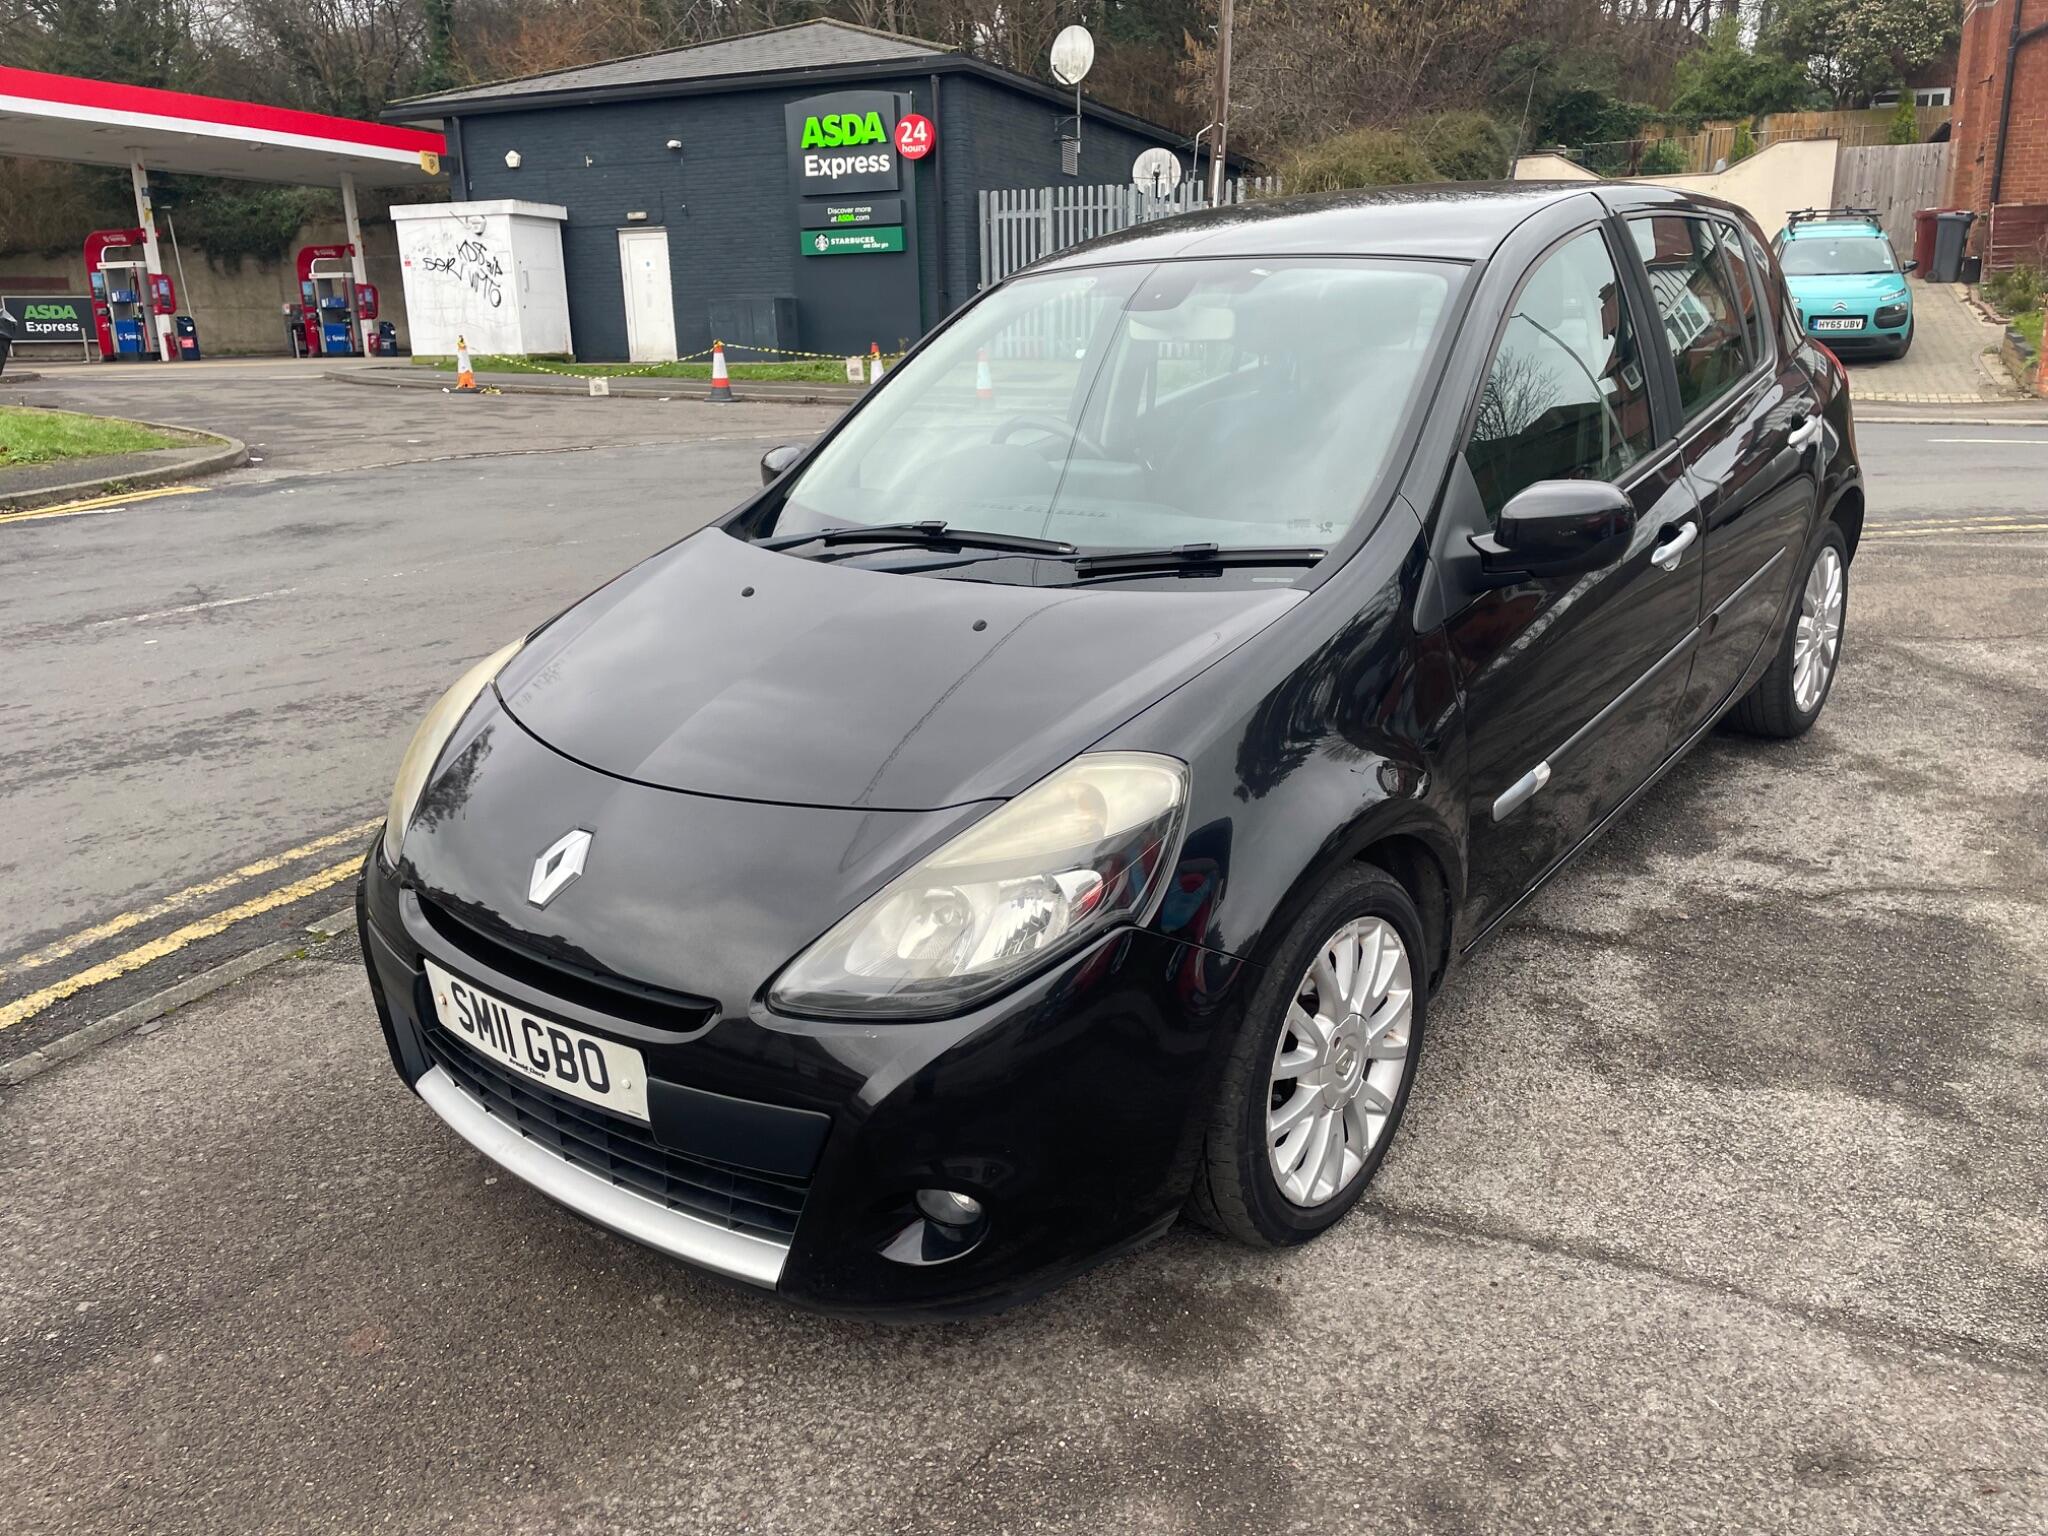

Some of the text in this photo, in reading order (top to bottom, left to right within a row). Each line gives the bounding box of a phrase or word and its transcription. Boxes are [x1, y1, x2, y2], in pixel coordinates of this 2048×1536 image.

[801, 112, 887, 148] ASDA
[901, 121, 927, 143] 24
[902, 144, 926, 153] hours
[804, 154, 890, 180] Express
[827, 207, 854, 215] Discover
[831, 236, 874, 245] STARBUCKS
[24, 305, 78, 320] ASDA
[26, 322, 79, 334] Express
[1819, 320, 1861, 328] HY65 UBV
[451, 981, 610, 1094] SM11 GBO
